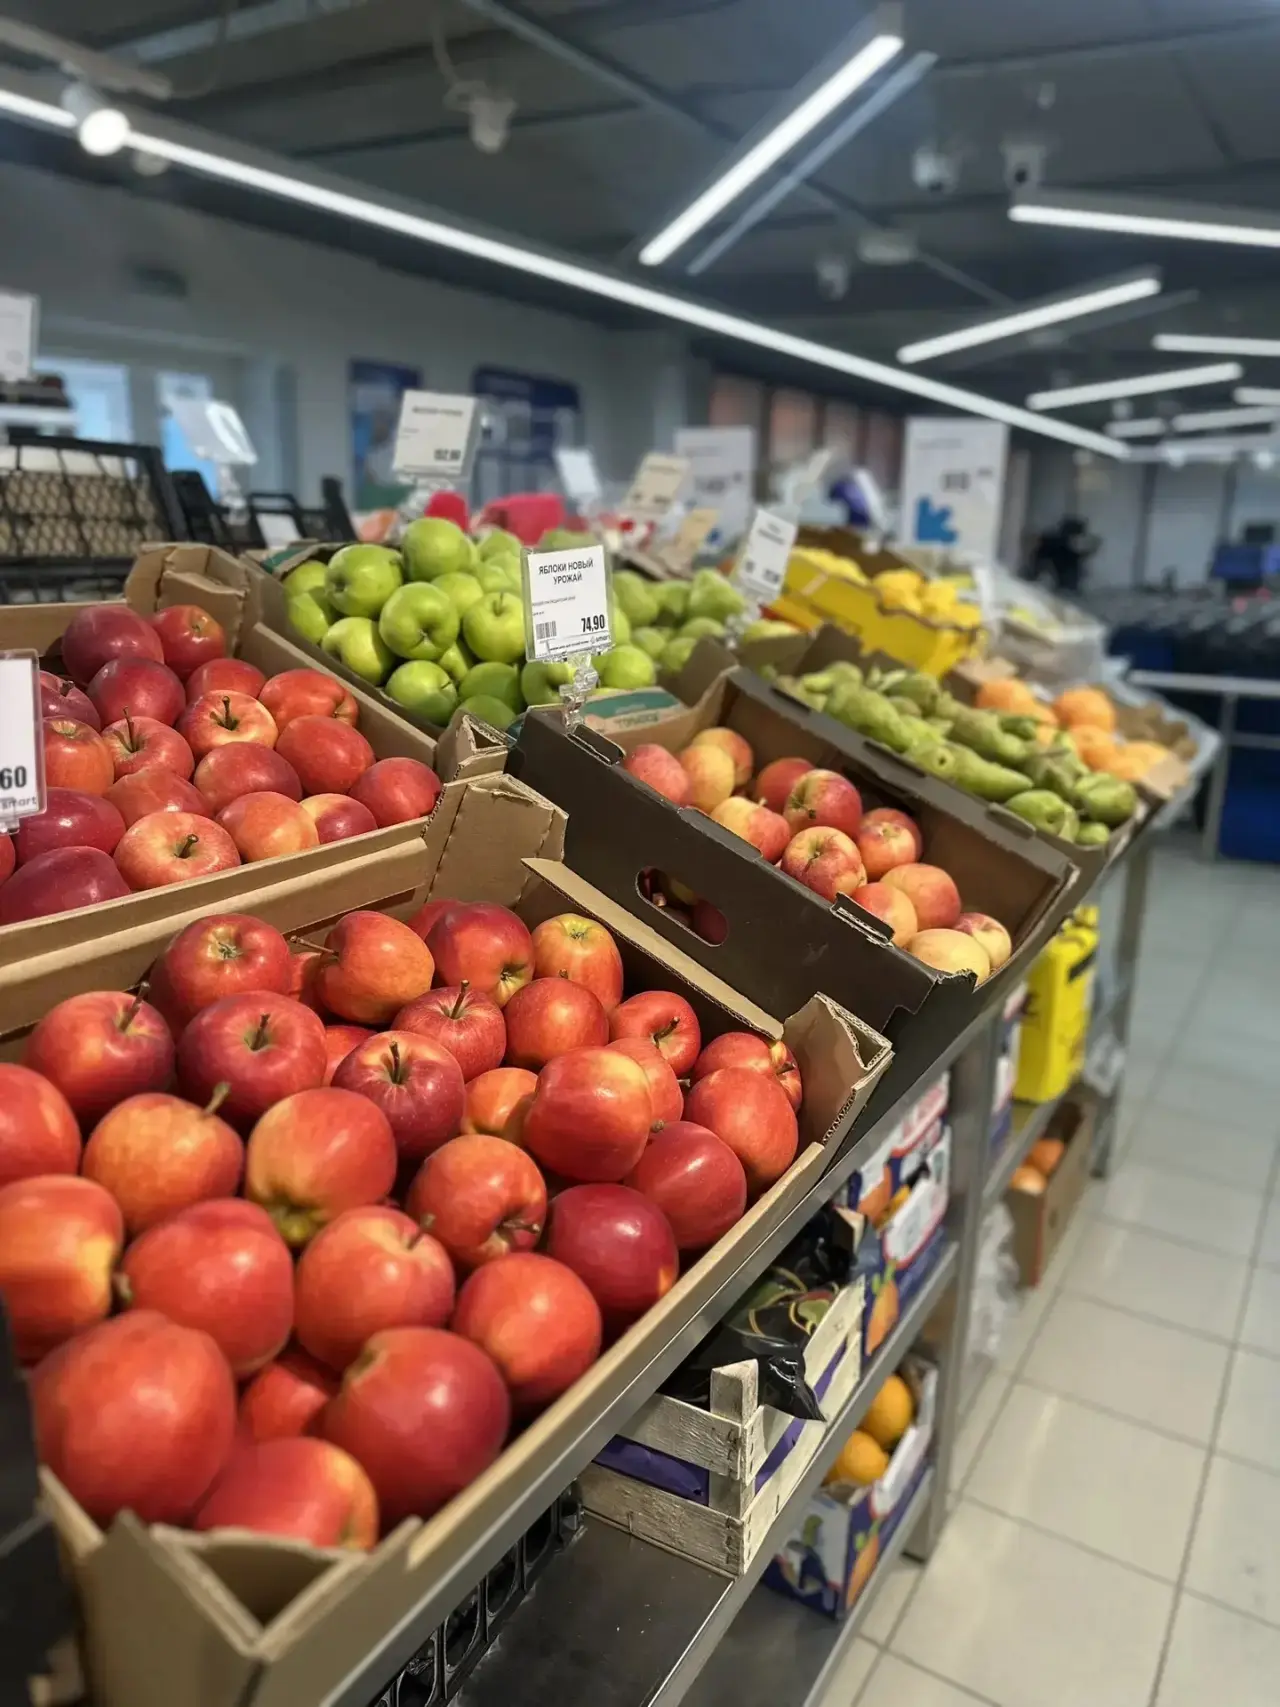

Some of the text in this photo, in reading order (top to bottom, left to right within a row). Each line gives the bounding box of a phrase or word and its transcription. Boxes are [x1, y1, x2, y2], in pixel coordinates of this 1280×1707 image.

[539, 557, 594, 575] ЯБЛОКИ НОВЫЙ
[553, 571, 583, 585] УРОЖАЙ
[581, 614, 605, 632] 74,90
